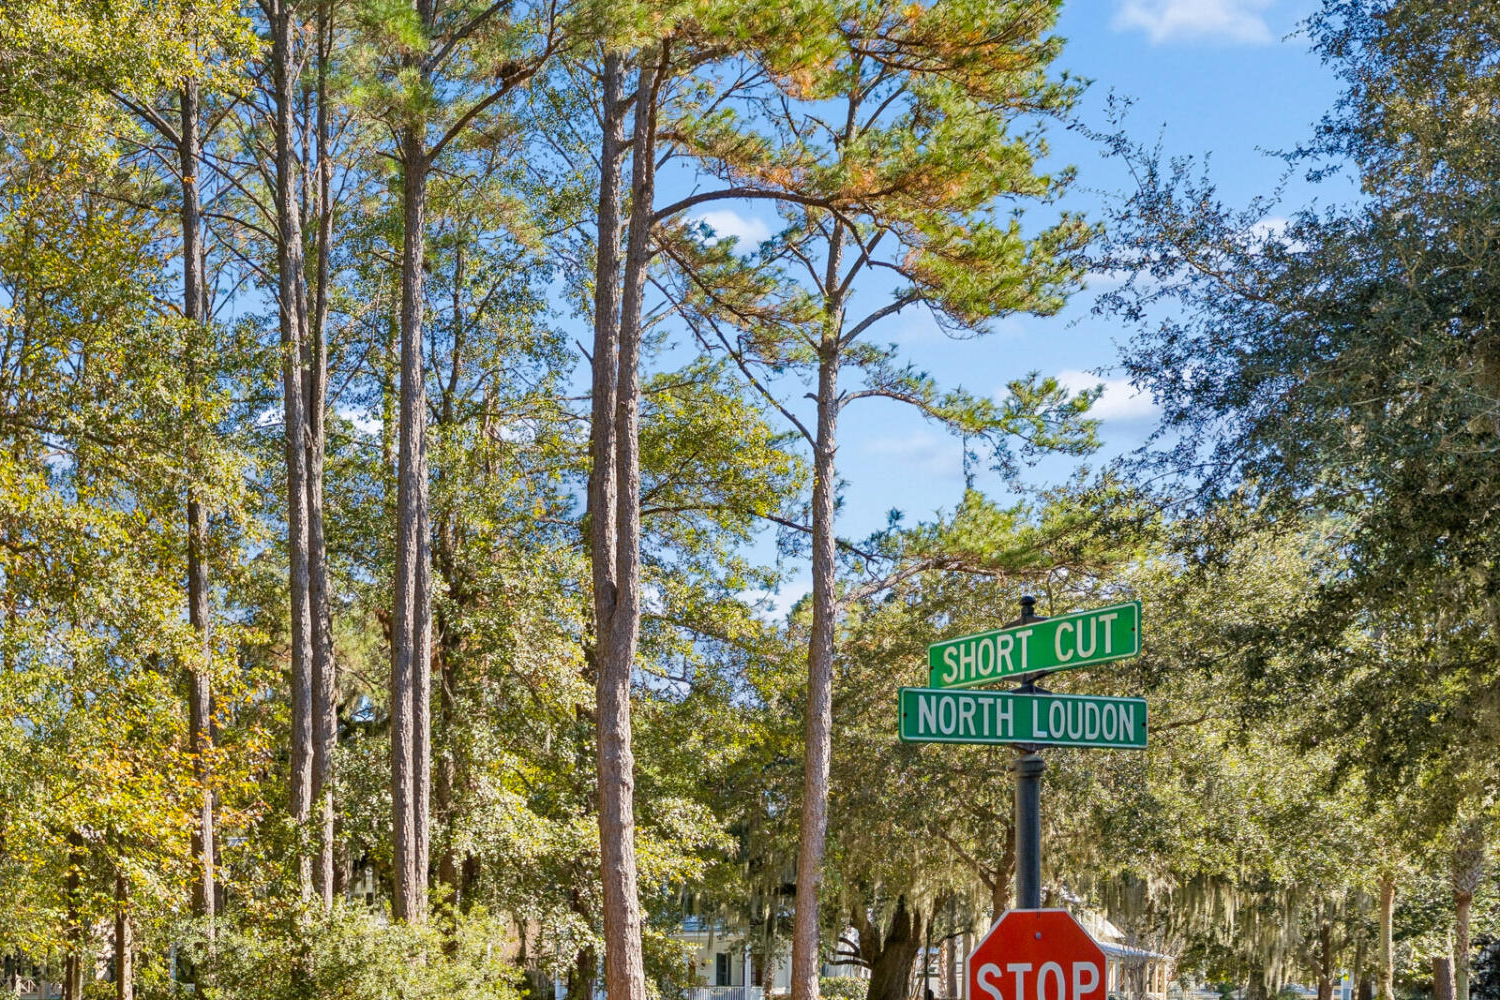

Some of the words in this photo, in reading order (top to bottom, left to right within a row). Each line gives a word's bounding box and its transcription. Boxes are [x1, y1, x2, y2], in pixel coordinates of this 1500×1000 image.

[942, 629, 1033, 683] SHORT
[1054, 612, 1118, 662] CUT
[917, 694, 1014, 737] NORTH
[1032, 699, 1135, 742] LOUDON
